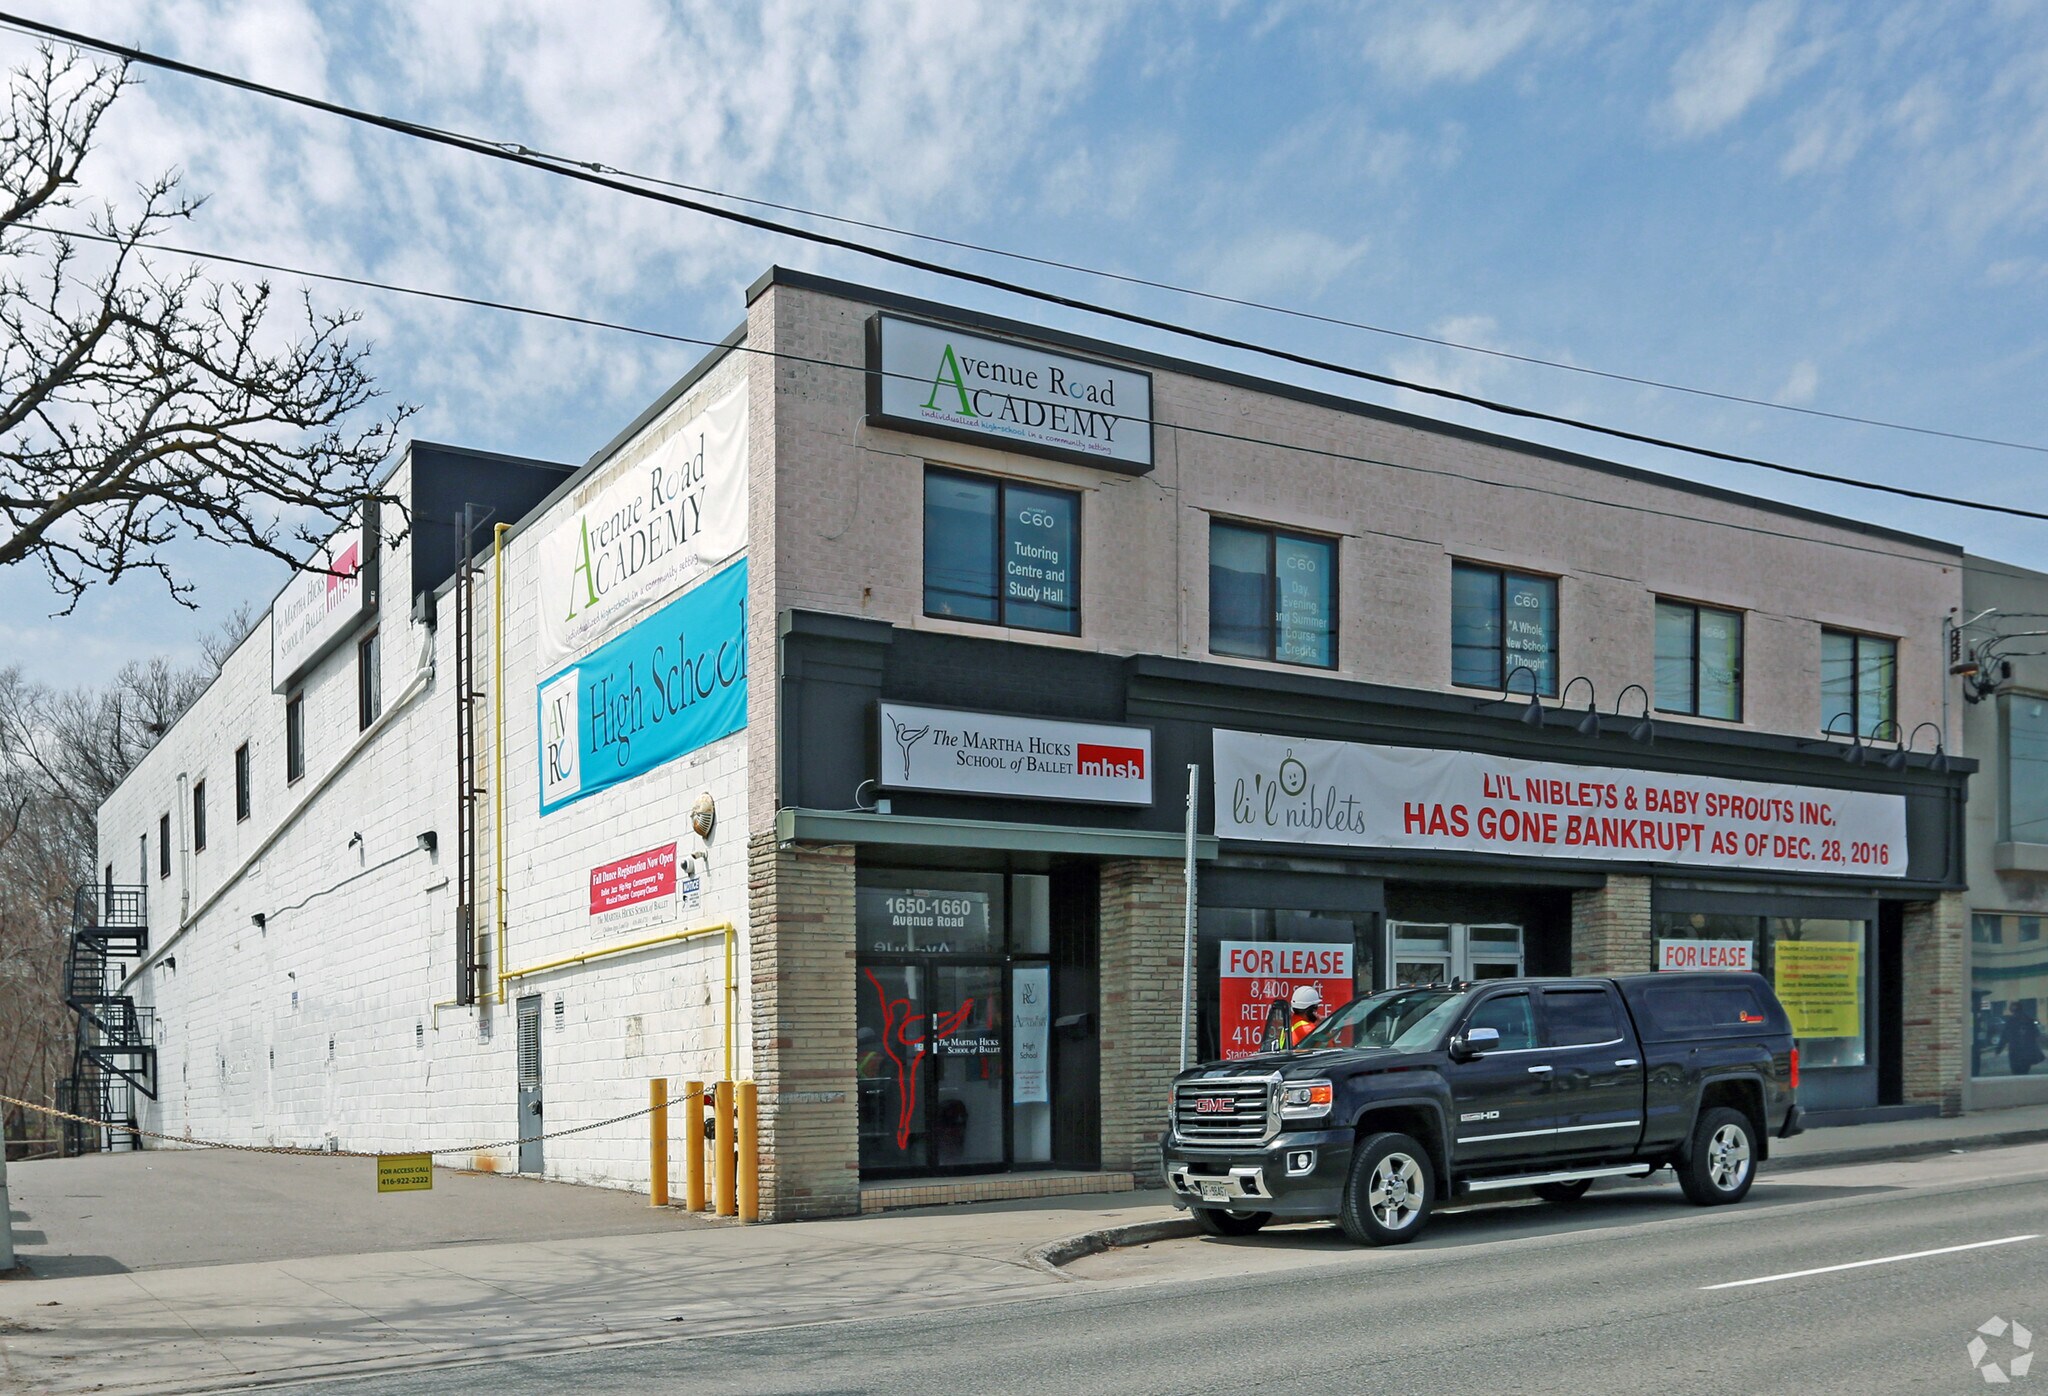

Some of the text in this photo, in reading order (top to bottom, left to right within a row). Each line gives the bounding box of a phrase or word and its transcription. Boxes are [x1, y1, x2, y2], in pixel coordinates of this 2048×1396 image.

[920, 344, 1116, 418] Avenue Road
[1045, 435, 1086, 451] community
[1088, 442, 1112, 454] setting
[565, 433, 706, 622] Avenue Road
[1019, 511, 1054, 528] C60
[1014, 541, 1059, 564] Tutoring
[1007, 561, 1065, 582] Centre and
[1286, 557, 1316, 572] C60
[1009, 581, 1063, 602] Study Hall
[1514, 594, 1539, 608] C60
[1292, 612, 1327, 629] Summer
[1285, 626, 1316, 642] Course
[1284, 642, 1317, 658] Credits
[1522, 639, 1548, 653] School
[590, 597, 747, 767] High School
[932, 729, 1141, 779] The MARTHA HICKS mhsb
[956, 750, 1073, 775] SCHOOL of BALLET
[1286, 784, 1366, 834] niblets
[1483, 772, 1837, 827] LI'L NIBLETS & BABY SPROUTS INC.
[1403, 802, 1889, 867] HAS GONE BANKRUPT AS OF DEC. 28, 2016
[592, 852, 674, 886] Fall Dance Registration Now Open
[886, 898, 971, 915] 1650-1660
[893, 915, 964, 927] Avenue Road
[1230, 949, 1344, 974] FOR LEASE
[1666, 946, 1746, 967] FOR LEASE
[1250, 980, 1289, 1000] 8,400
[1022, 1042, 1035, 1051] High
[1226, 1048, 1260, 1060] Starba
[1195, 1098, 1235, 1113] GMC
[381, 1176, 429, 1185] 416-922-2222
